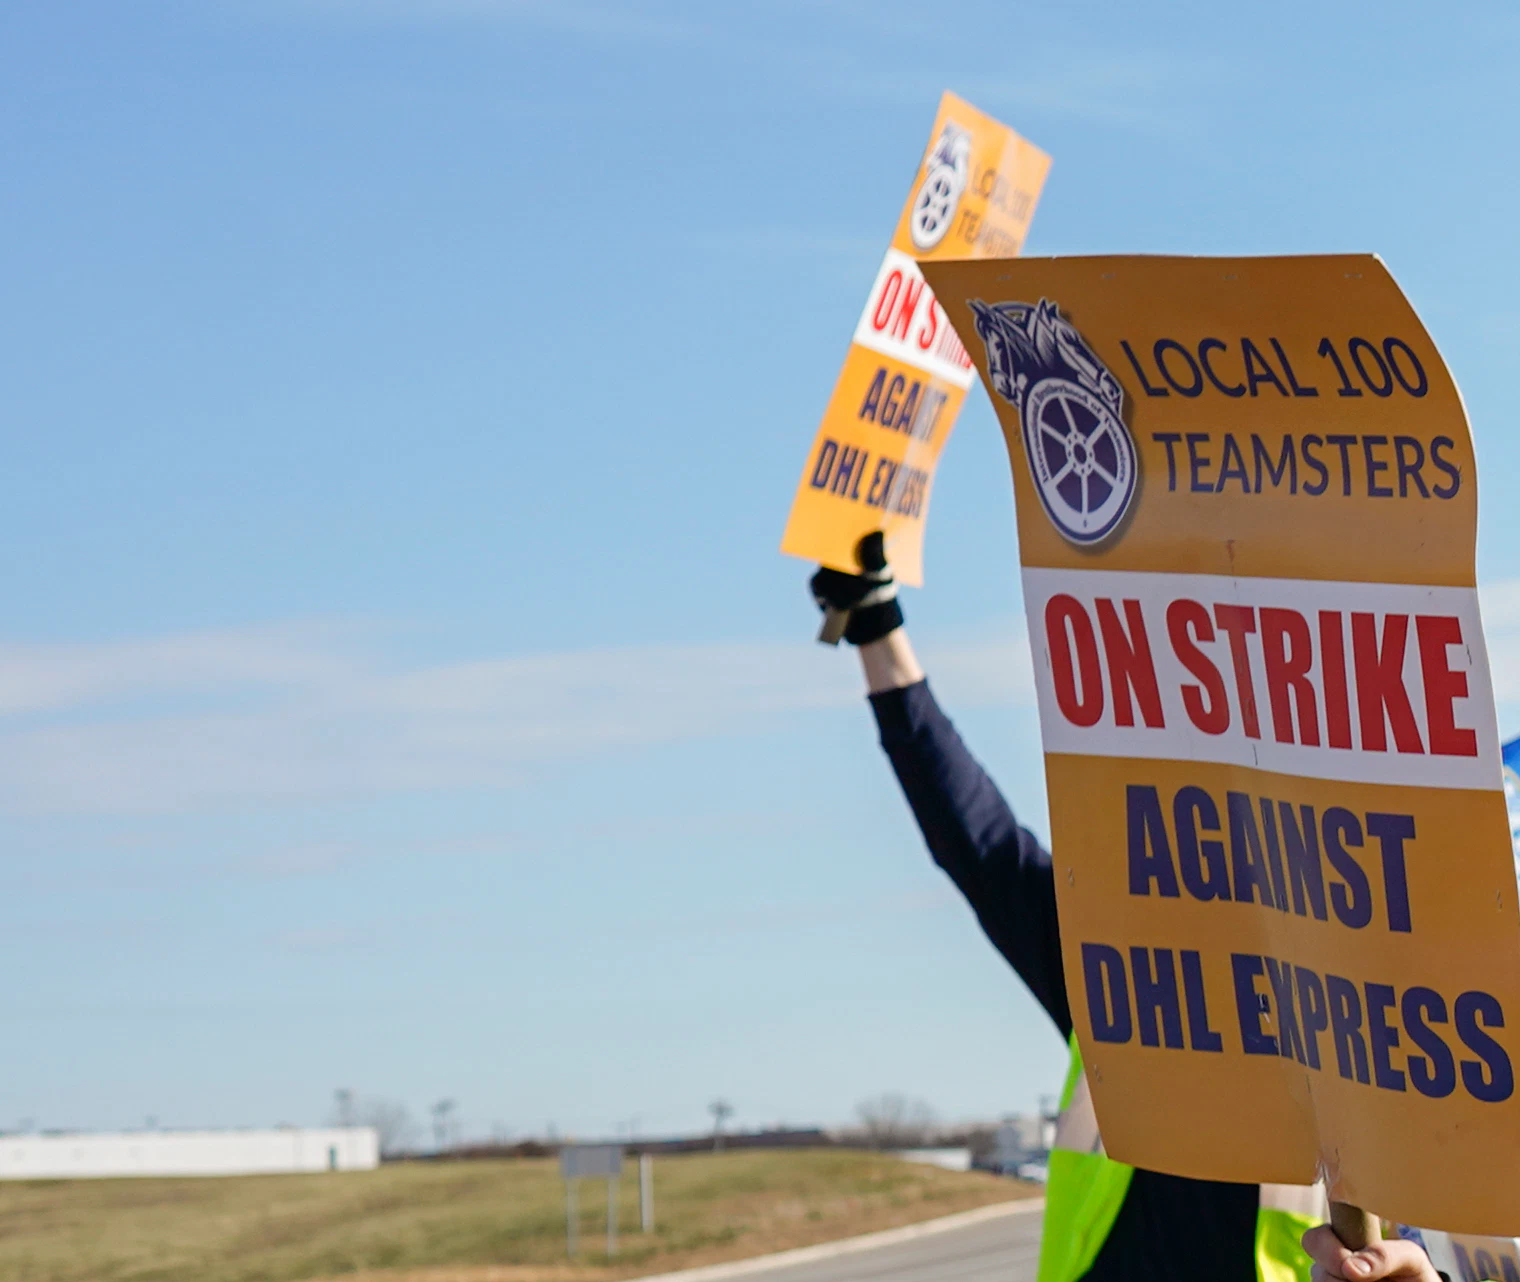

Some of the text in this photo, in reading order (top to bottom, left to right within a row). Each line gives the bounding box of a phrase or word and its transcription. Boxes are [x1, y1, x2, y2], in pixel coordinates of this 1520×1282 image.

[872, 269, 926, 341] ON
[1119, 337, 1429, 398] LOCAL 100
[810, 439, 930, 519] DHL EXESS
[1152, 432, 1462, 500] TEAMSTERS
[1044, 593, 1479, 758] ON STRIKE
[1125, 784, 1416, 934] AGAINST
[1081, 943, 1515, 1103] DHL EXPRESS
